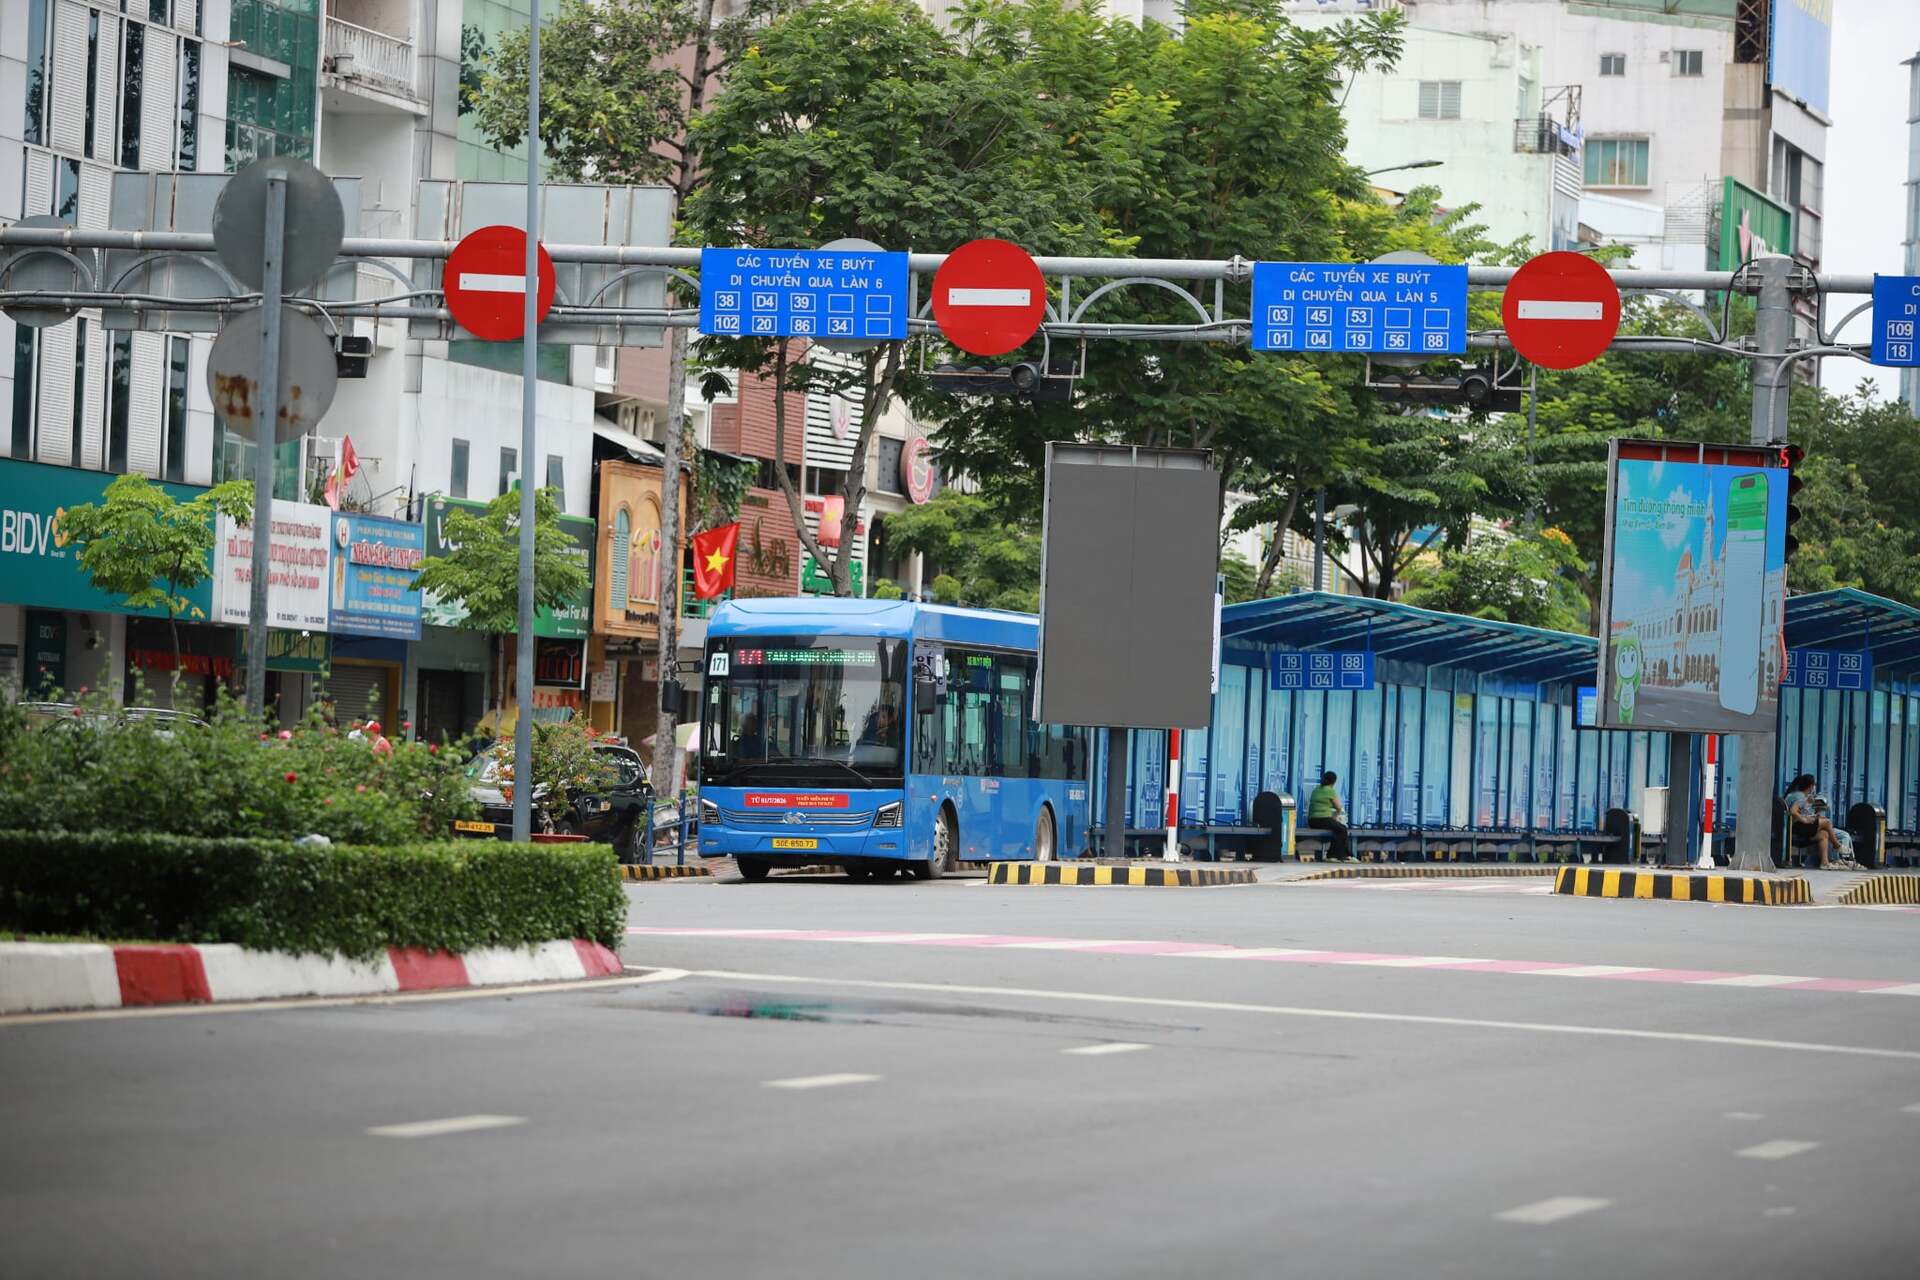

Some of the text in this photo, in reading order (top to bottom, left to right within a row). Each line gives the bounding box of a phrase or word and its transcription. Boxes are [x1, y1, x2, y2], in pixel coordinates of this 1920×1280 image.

[736, 253, 875, 270] CÁC TUYẾN XE BUÝT
[730, 271, 883, 289] DI CHUYỂN QUA LÀN 6
[1290, 267, 1430, 284] CÁC TUYẾN XE BUÝT
[1284, 285, 1438, 303] DI CHUYỂN QUA LÀN 5
[719, 295, 809, 309] 38 D4 39
[1272, 309, 1367, 323] 03 45 53
[1905, 304, 1917, 315] DI
[716, 317, 847, 332] 102 20 86 34
[1889, 323, 1913, 336] 109
[1273, 333, 1443, 347] 01 04 19 56 88
[1891, 345, 1907, 358] 18
[2, 509, 53, 556] BIDV
[712, 657, 727, 672] 171
[1286, 656, 1360, 668] 19 56 88
[1811, 654, 1823, 666] 31
[1842, 656, 1858, 668] 36
[1285, 674, 1330, 685] 01 04
[1809, 672, 1825, 684] 65
